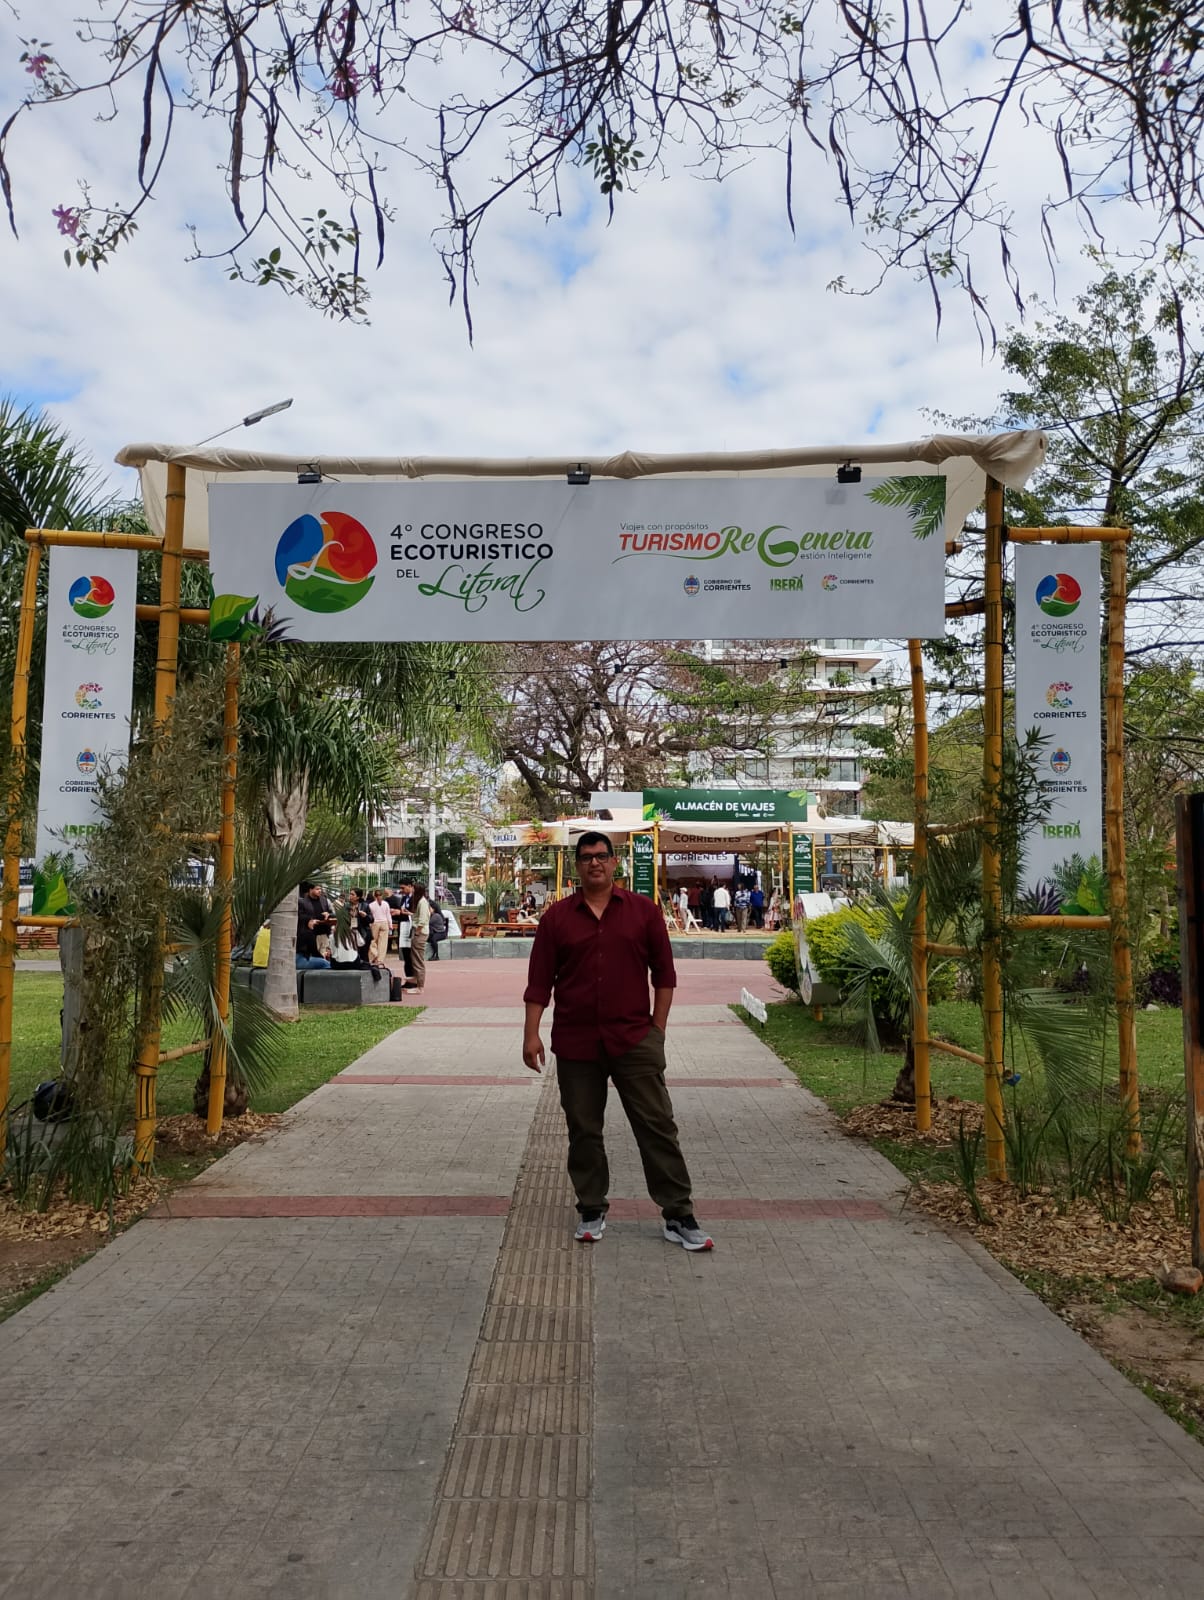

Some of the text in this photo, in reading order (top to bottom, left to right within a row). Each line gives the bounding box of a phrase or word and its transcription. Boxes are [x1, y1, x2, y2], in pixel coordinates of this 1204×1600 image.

[420, 523, 543, 540] CONGRESO
[620, 523, 645, 532] Viajes
[665, 522, 709, 532] propósitos
[619, 532, 720, 551] TURISMO
[390, 543, 554, 560] ECOTURISTICO
[800, 551, 826, 560] estión
[396, 559, 545, 613] DEL Litoral
[770, 574, 804, 591] IBERÁ
[62, 631, 120, 639] ECOTURISTICO
[61, 711, 116, 720] CORRIENTES
[1033, 711, 1087, 719] CORRIENTES
[674, 800, 776, 811] ALMACÉN DE VIAJES
[1042, 820, 1081, 839] IBERÁ
[673, 834, 741, 843] CORRIENTES
